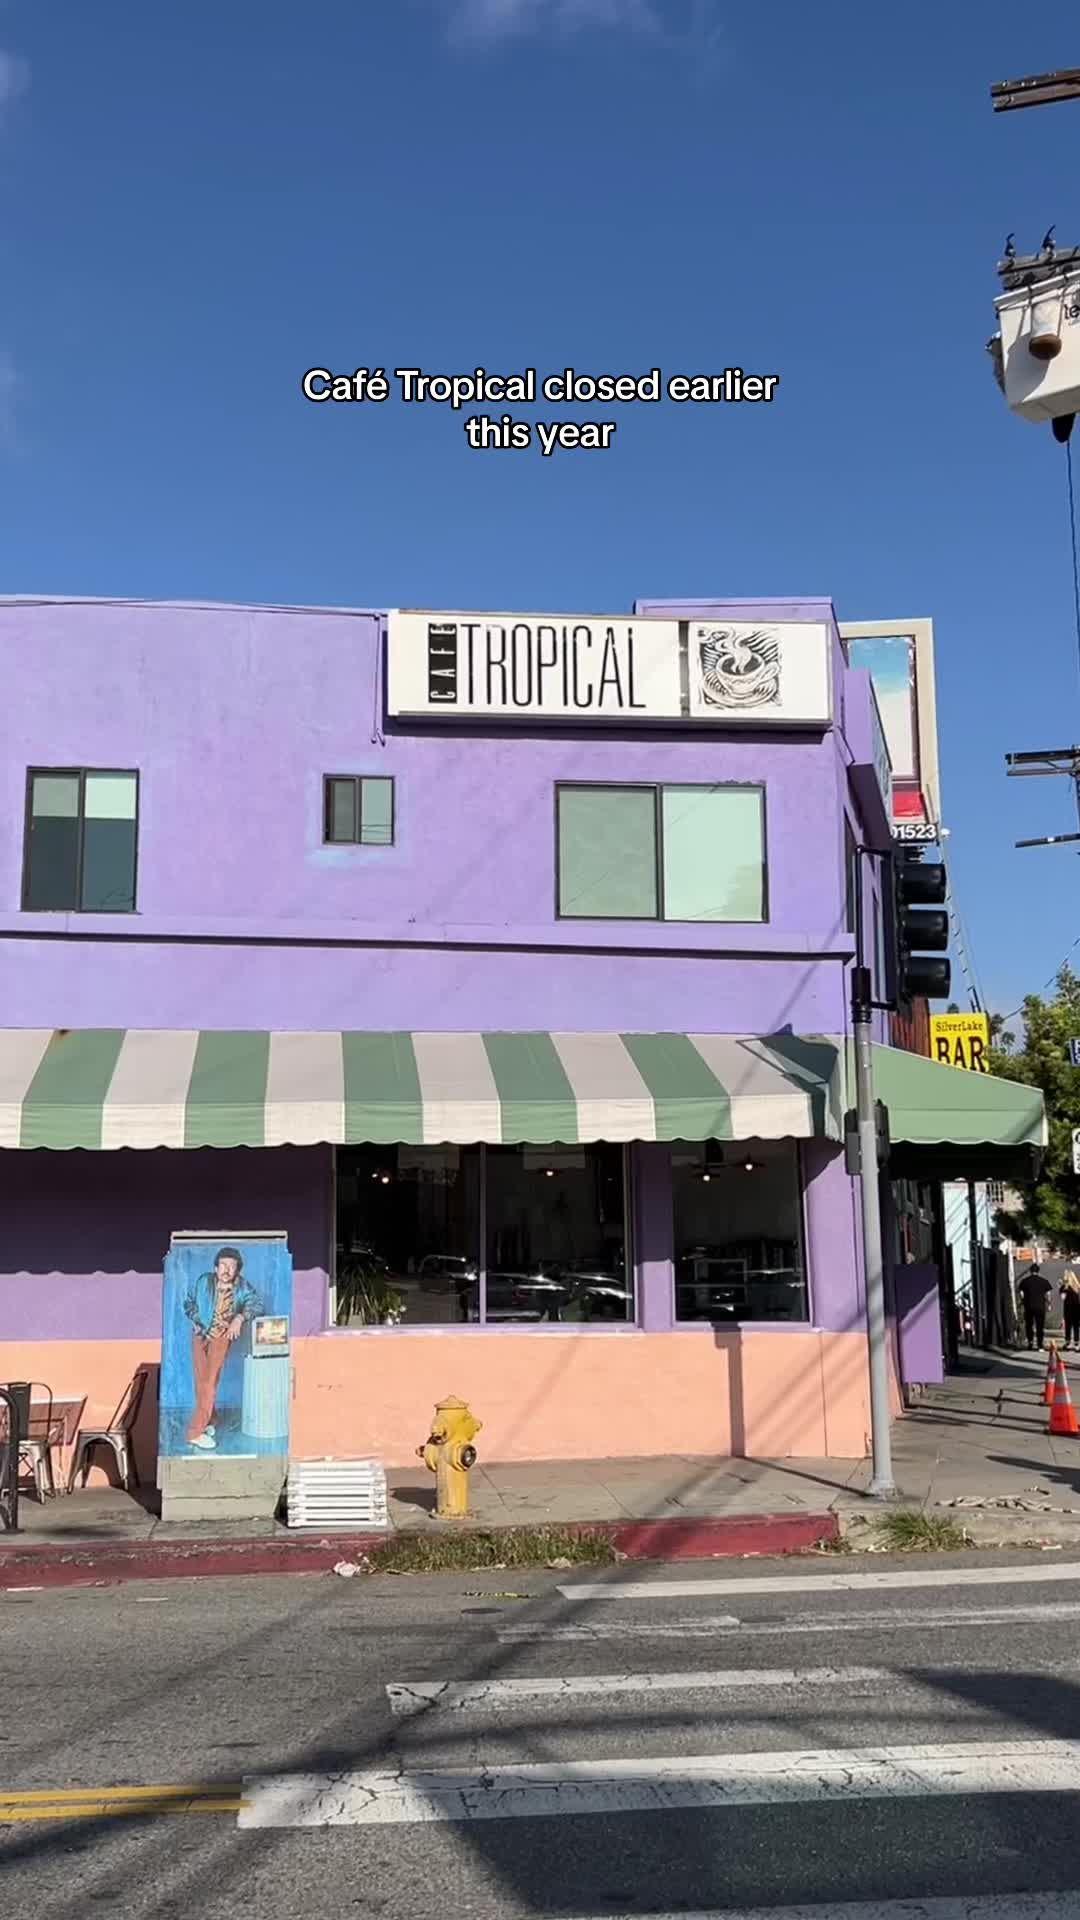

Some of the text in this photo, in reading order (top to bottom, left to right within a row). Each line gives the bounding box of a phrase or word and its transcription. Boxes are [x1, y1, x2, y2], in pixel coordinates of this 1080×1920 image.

[429, 623, 646, 708] CAFE TROPICAL
[936, 1036, 986, 1073] BAR
